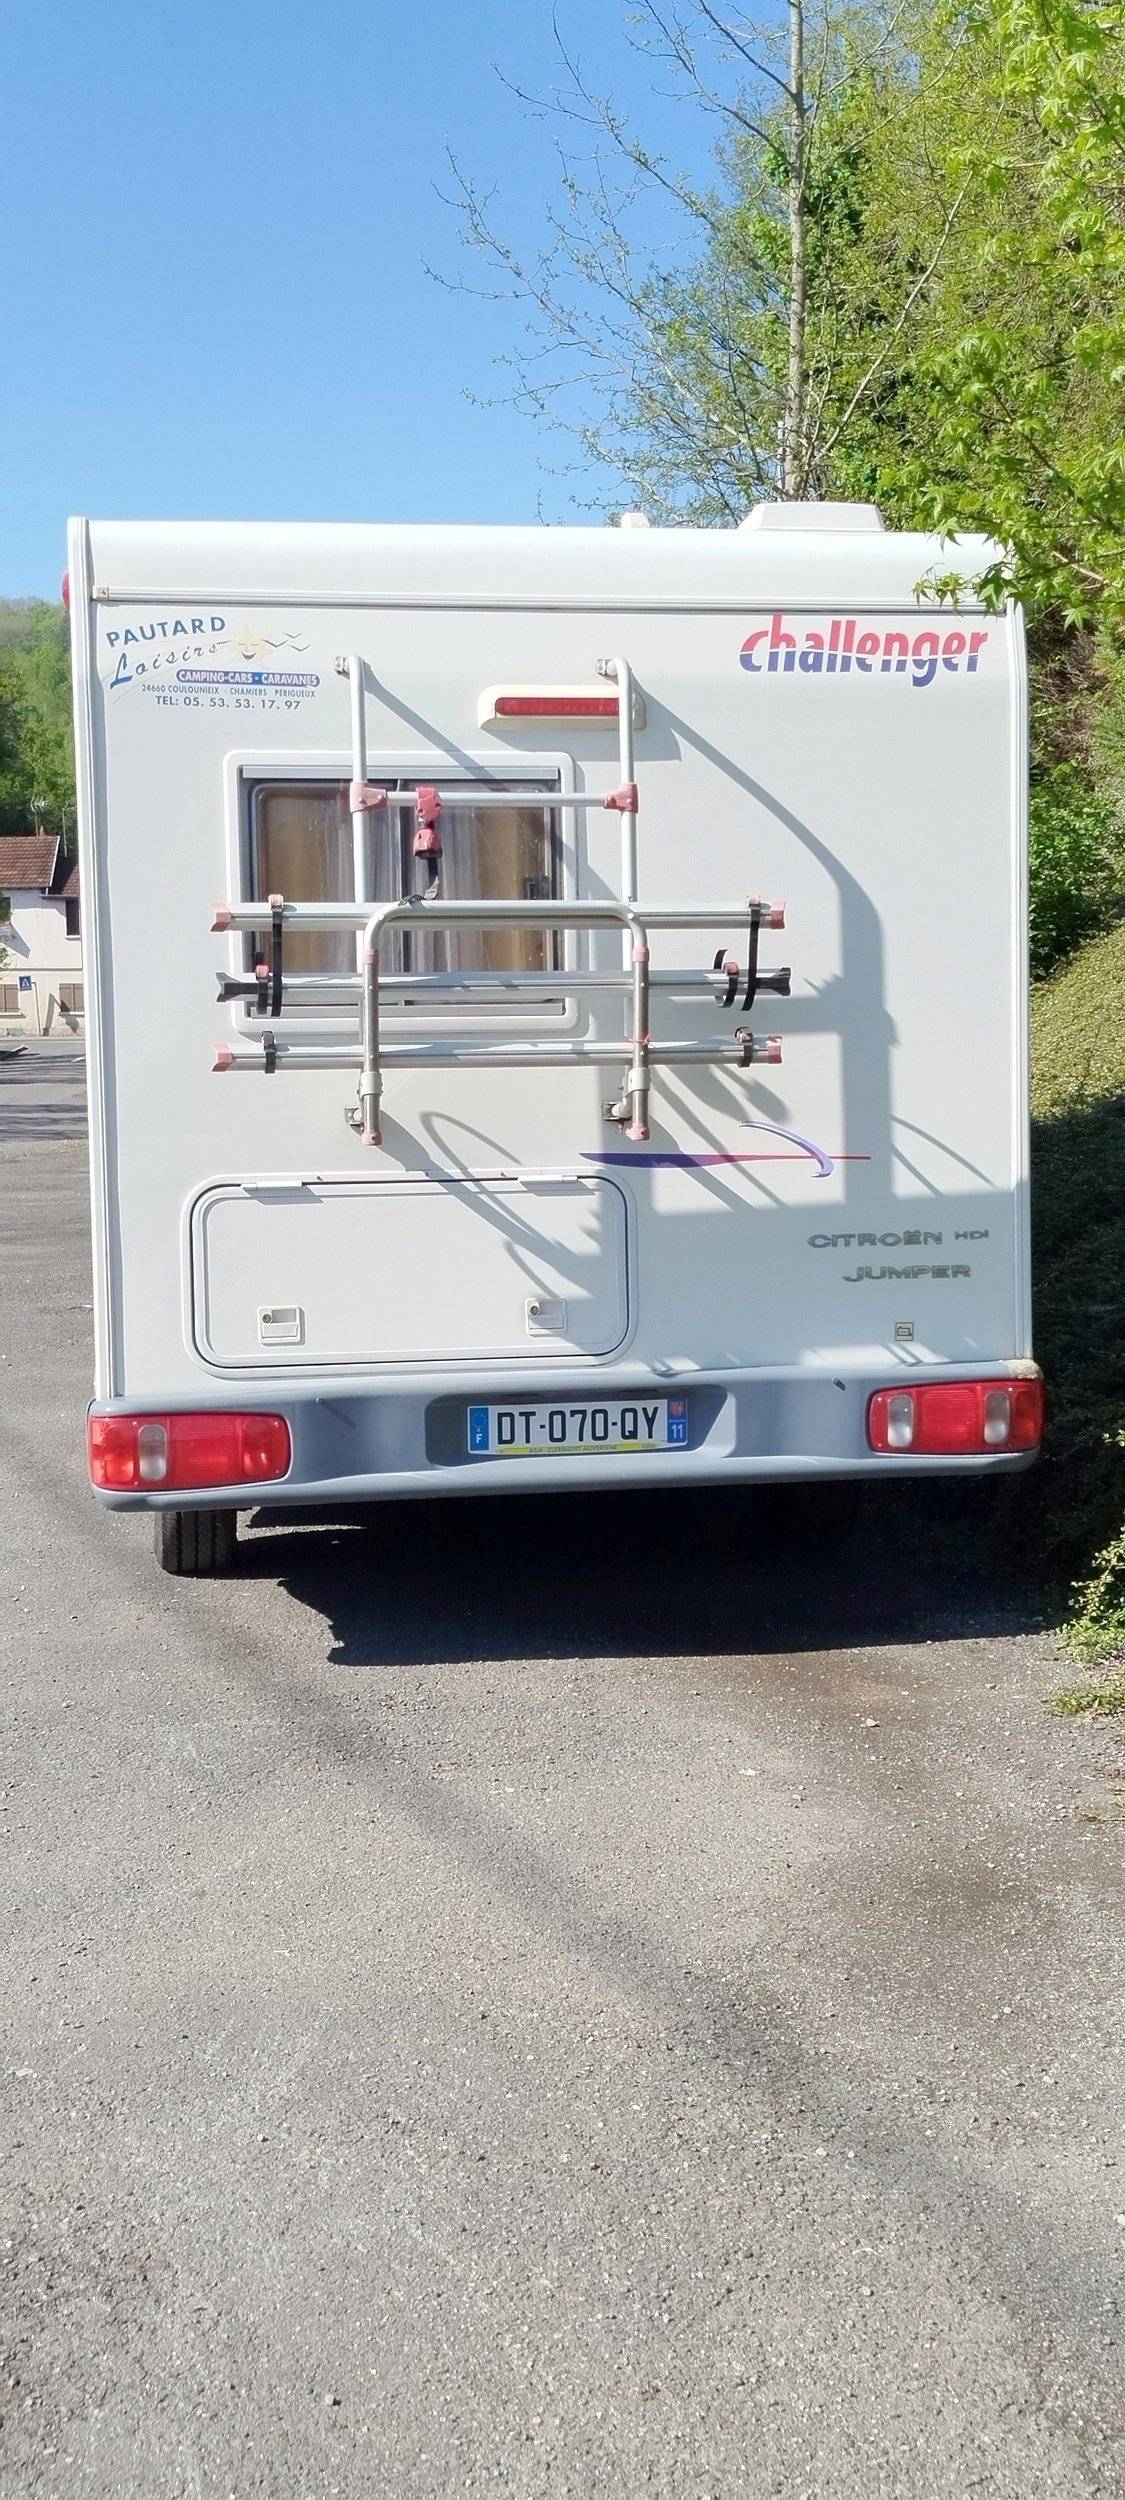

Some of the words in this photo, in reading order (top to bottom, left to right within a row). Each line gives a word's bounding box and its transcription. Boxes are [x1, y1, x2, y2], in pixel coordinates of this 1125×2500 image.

[106, 616, 226, 648] PAUTARD
[739, 611, 989, 688] challenger
[110, 641, 226, 690] Loisirs
[178, 669, 253, 684] CAMPING-CARS
[261, 673, 318, 687] CARAVANES
[141, 683, 166, 693] 24660
[229, 687, 268, 697] CHAMIERS
[156, 695, 179, 706] TEL:
[285, 700, 301, 710] 97
[807, 1229, 943, 1249] CITROËN
[842, 1264, 972, 1283] JUMPER
[497, 1406, 660, 1446] DT-070-QY
[671, 1423, 683, 1440] 11
[475, 1432, 483, 1444] F
